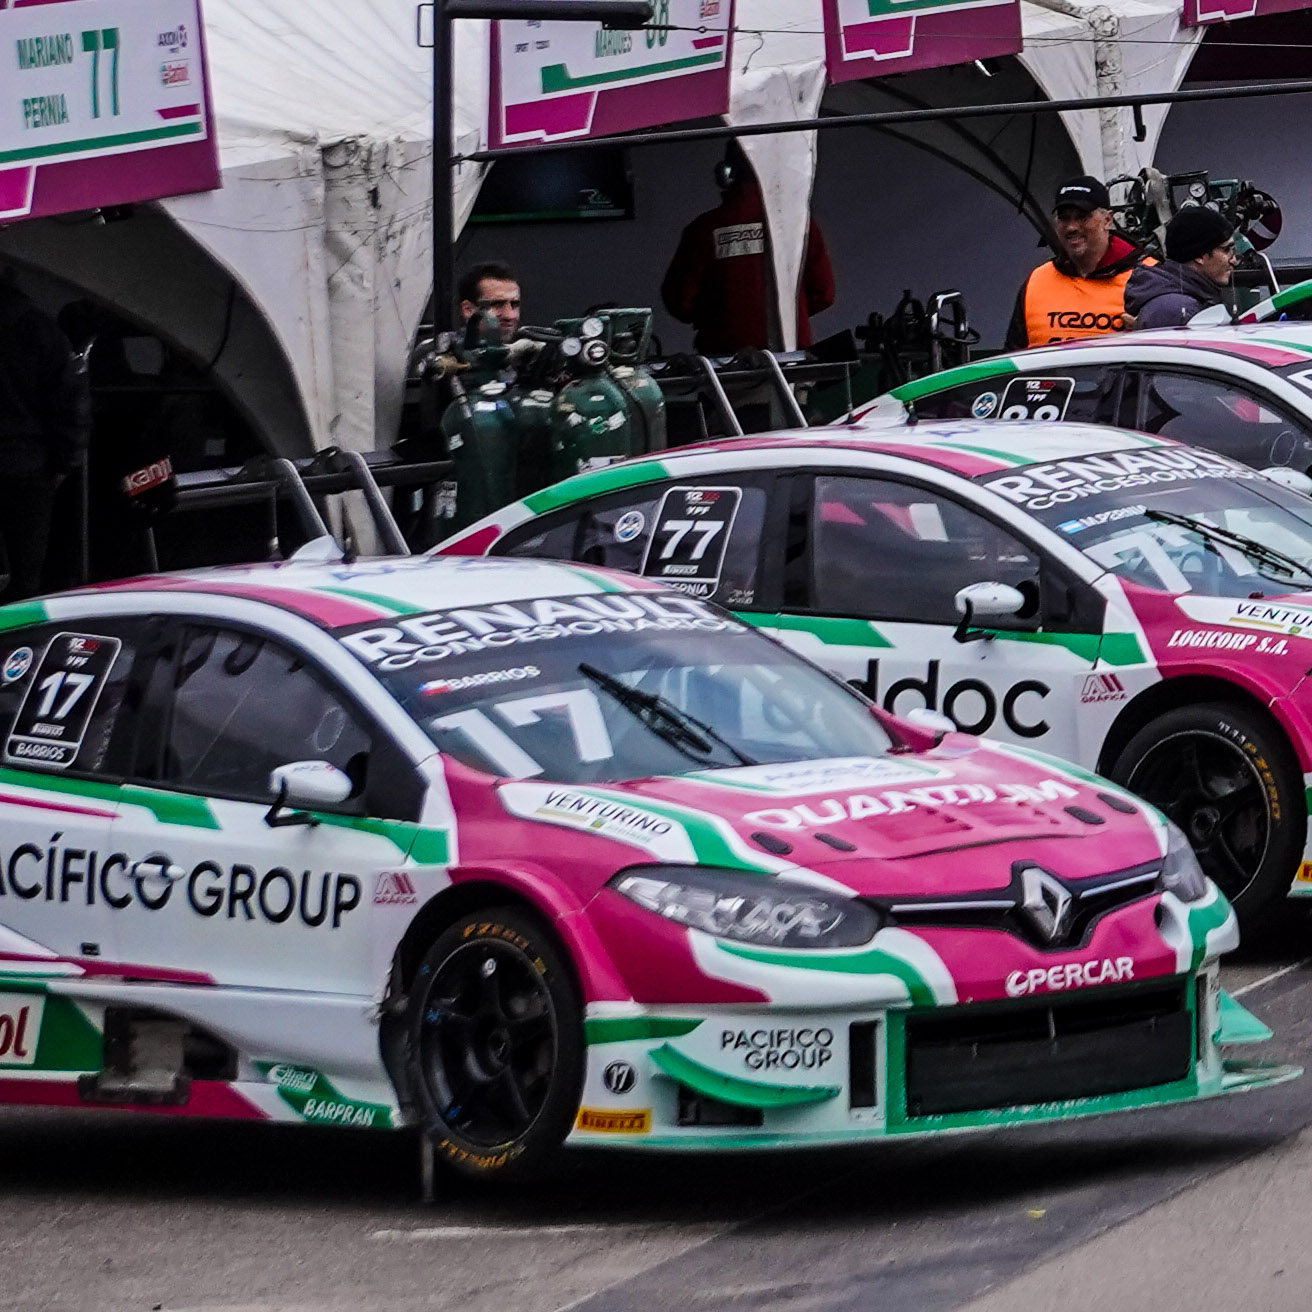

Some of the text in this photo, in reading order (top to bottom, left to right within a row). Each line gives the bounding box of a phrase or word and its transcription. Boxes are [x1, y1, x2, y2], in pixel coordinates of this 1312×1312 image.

[17, 33, 74, 70] MARIANO
[82, 28, 120, 119] 77
[23, 94, 69, 129] PERNIA
[1027, 393, 1047, 403] YPF
[983, 446, 1236, 505] RENAULT
[686, 505, 711, 516] YPF
[659, 519, 725, 561] 77
[339, 594, 720, 663] RENAULT
[1167, 628, 1290, 656] LOGICORP S.A.
[37, 671, 96, 720] 17
[447, 665, 542, 692] BARRIOS
[845, 657, 1053, 738] ddoc
[430, 688, 615, 779] 17
[15, 742, 67, 761] BARRIOS
[544, 790, 673, 836] VENTURINO
[0, 831, 363, 929] CÍFICO GROUP
[720, 1026, 835, 1052] PACIFICO
[744, 1045, 833, 1072] GROUP
[609, 1064, 630, 1089] 17
[303, 1097, 378, 1128] BARPRAN
[578, 1109, 648, 1133] PIRELLI
